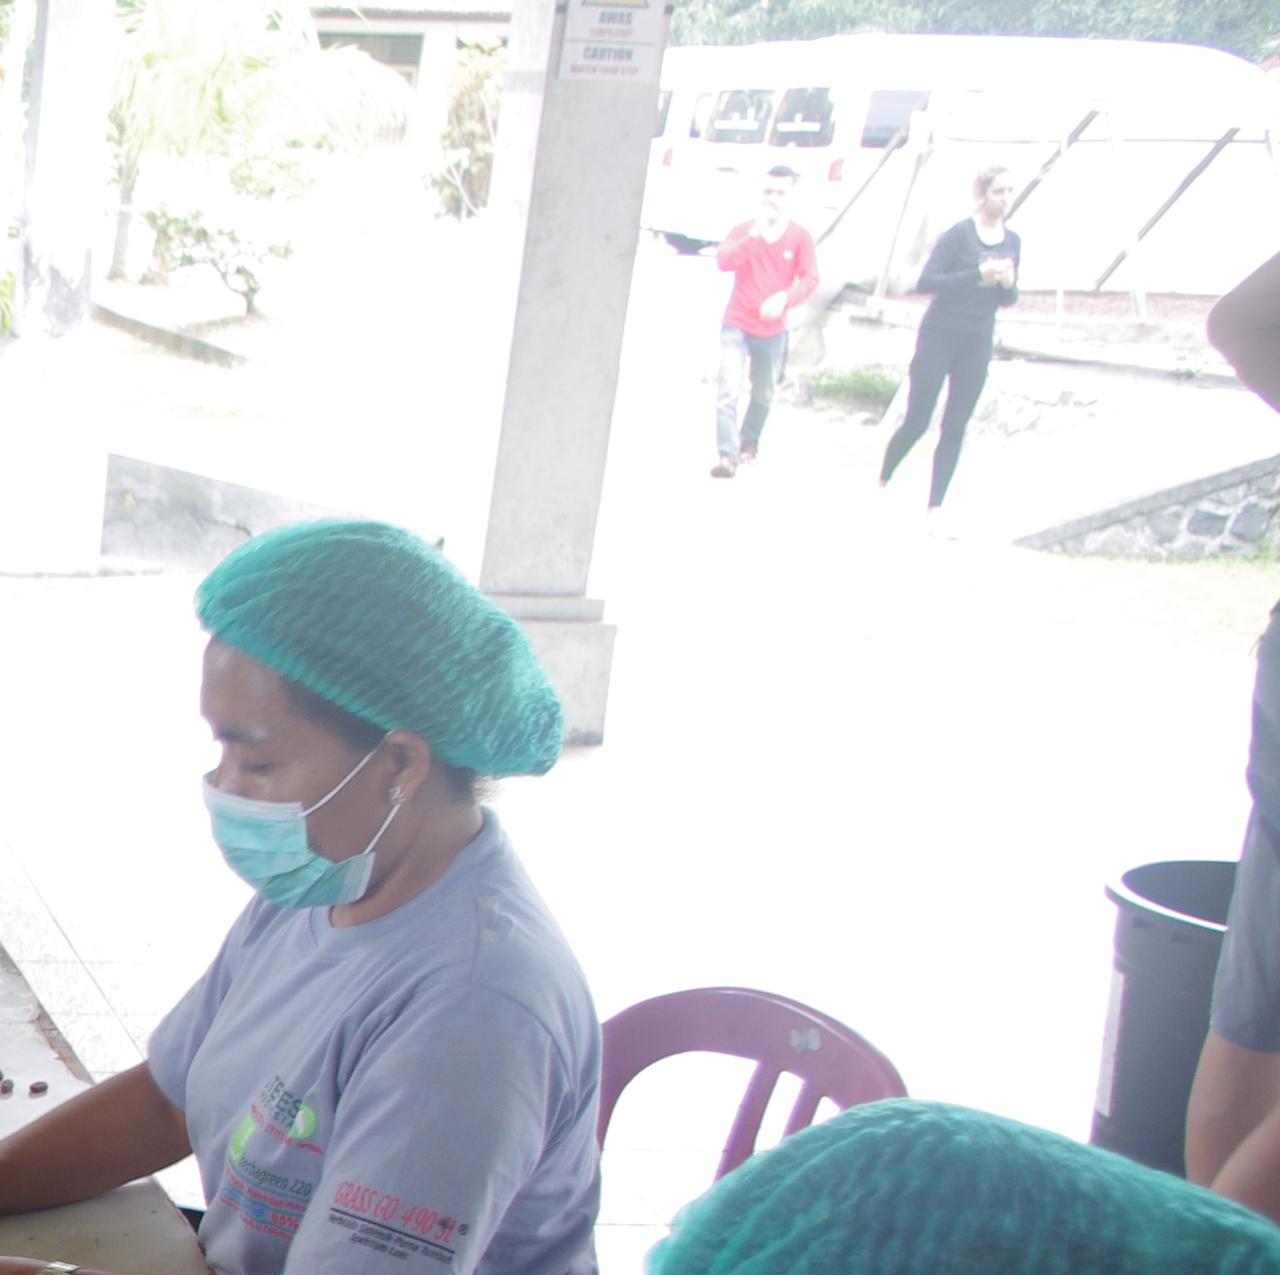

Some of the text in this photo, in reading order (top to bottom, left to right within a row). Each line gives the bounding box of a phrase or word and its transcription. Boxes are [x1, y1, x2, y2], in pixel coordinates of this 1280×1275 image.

[583, 46, 634, 61] CAUTION
[335, 1180, 378, 1214] GRASS
[373, 1195, 401, 1222] GO
[401, 1205, 439, 1235] 490
